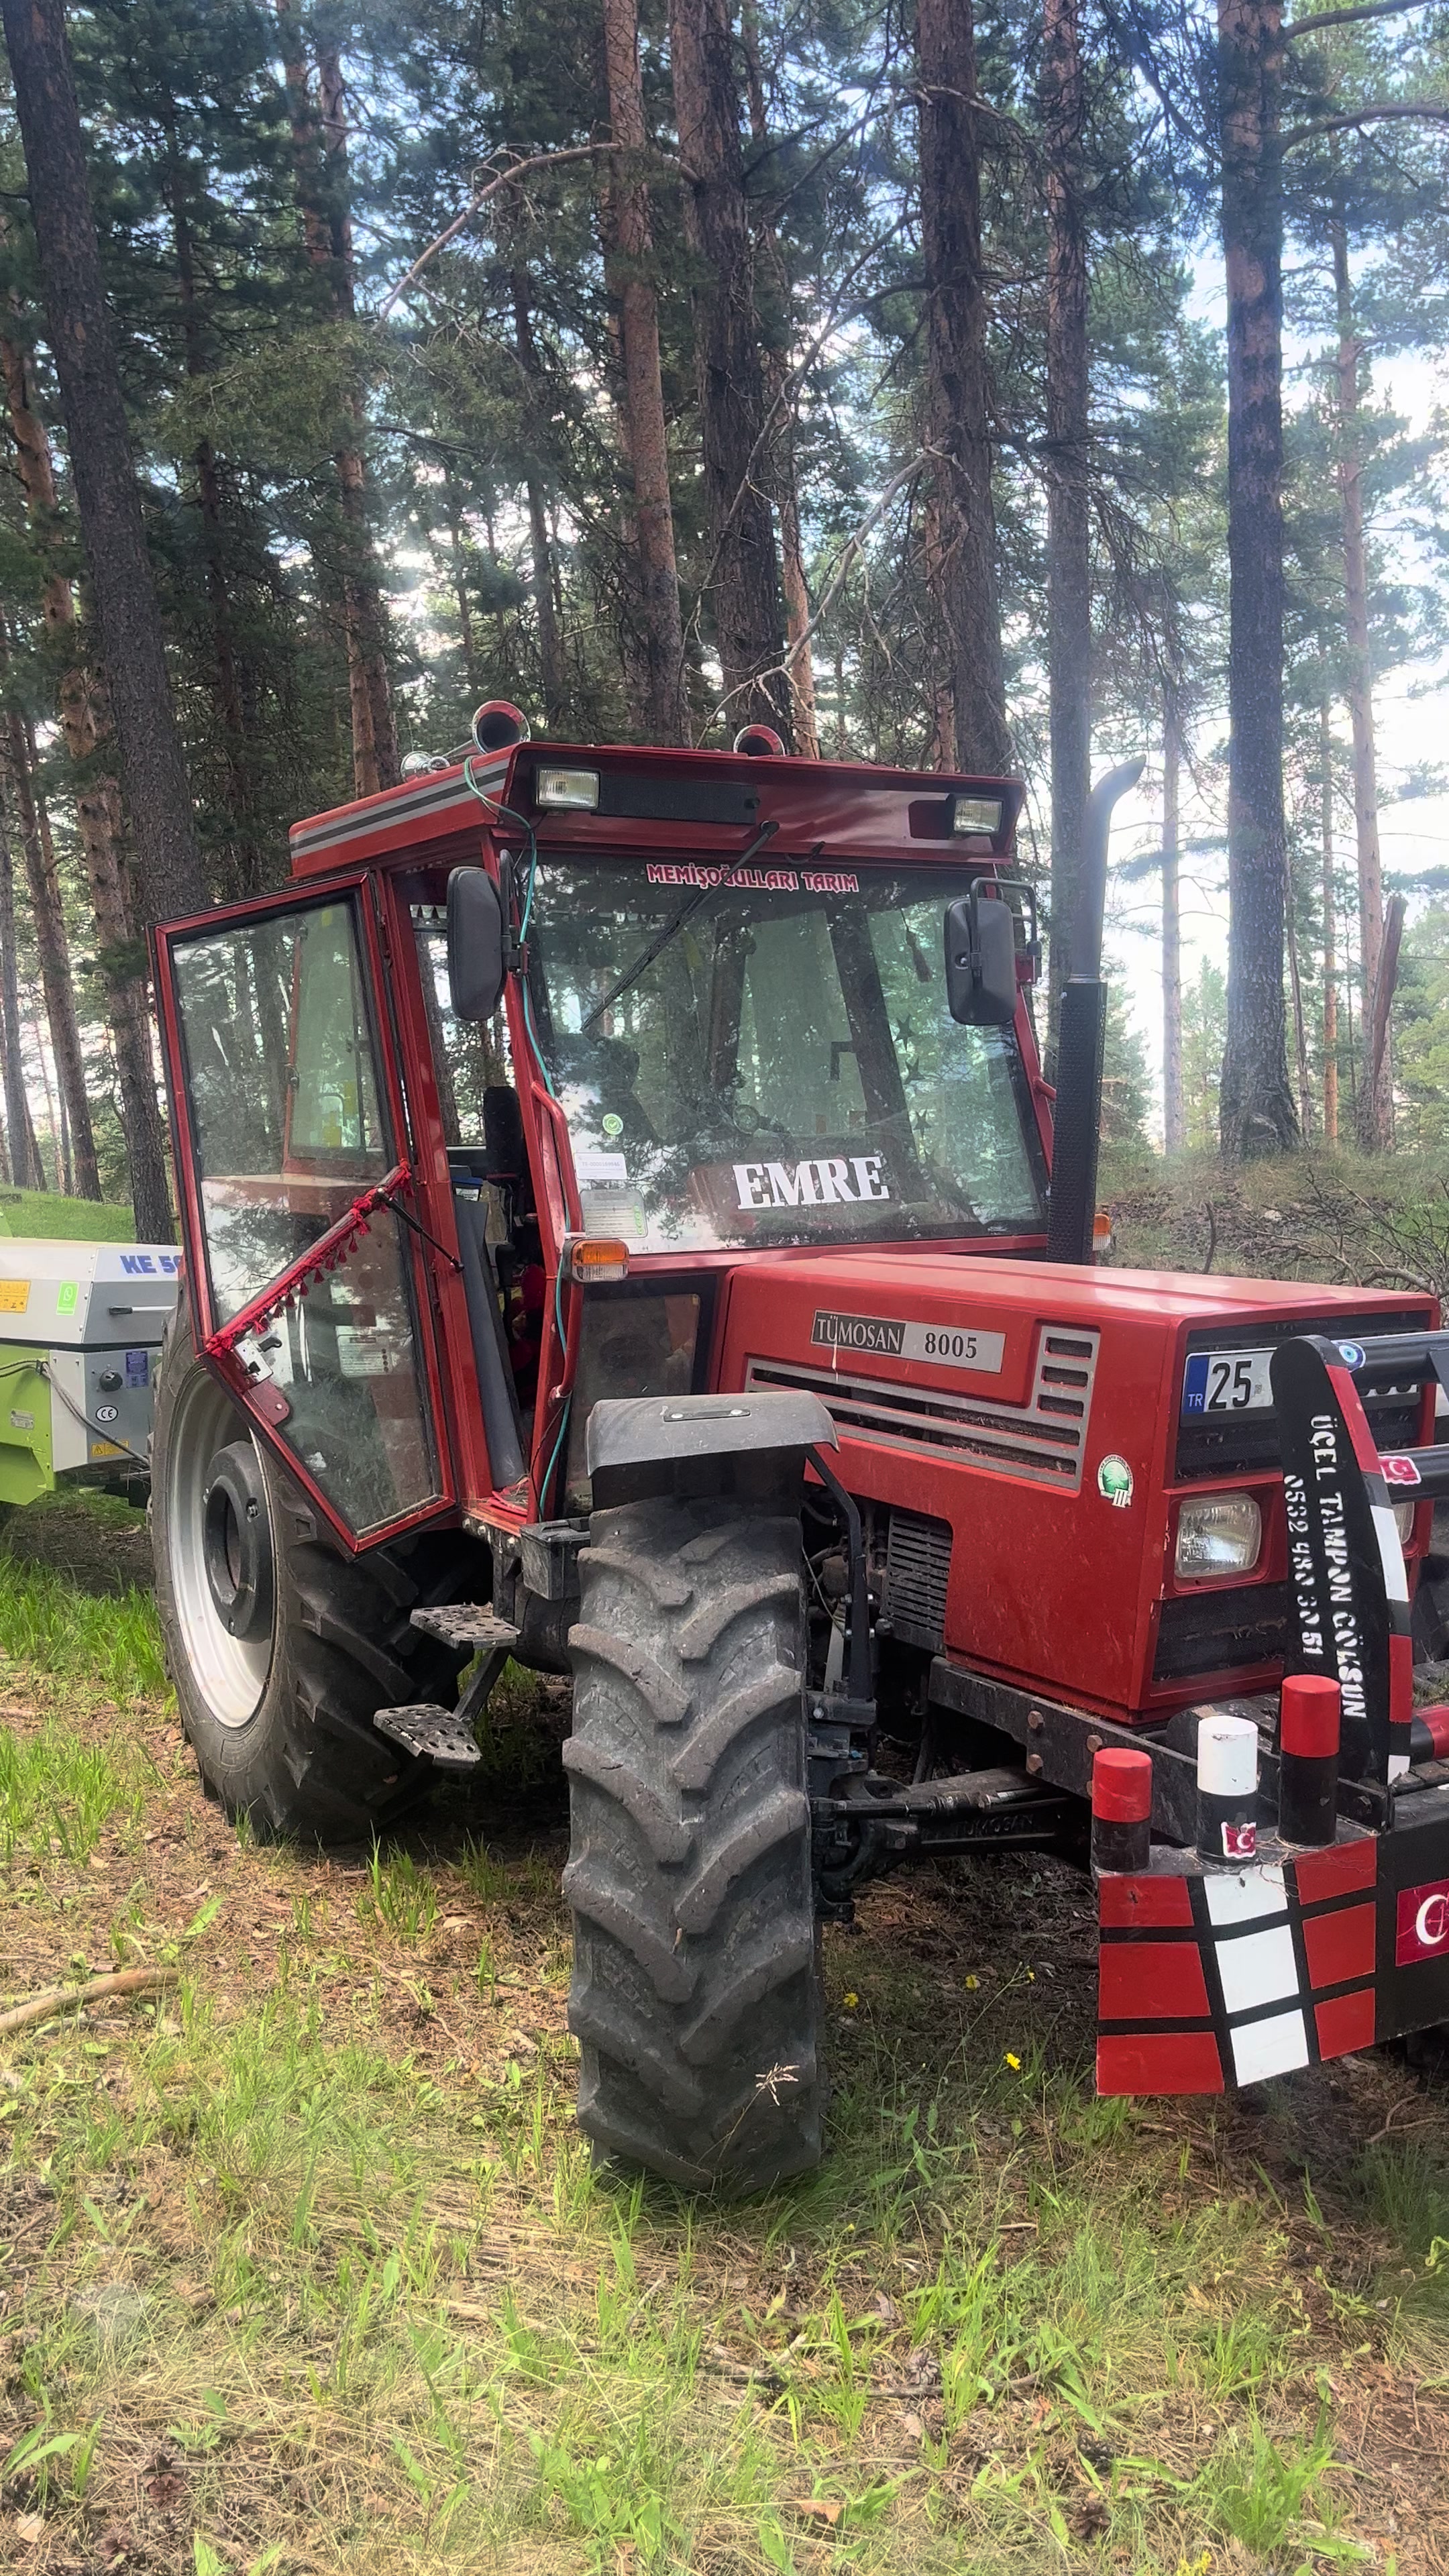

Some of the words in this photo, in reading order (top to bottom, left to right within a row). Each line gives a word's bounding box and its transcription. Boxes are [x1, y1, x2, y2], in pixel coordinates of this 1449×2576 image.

[802, 872, 859, 893] TARIM
[733, 1156, 890, 1210] EMRE
[119, 1255, 157, 1274] KE
[816, 1316, 901, 1351] TÜMOSAN
[924, 1332, 977, 1359] 8005
[1188, 1393, 1203, 1407] TR
[1208, 1360, 1252, 1410] 25
[101, 1409, 113, 1419] CE
[1309, 1415, 1338, 1481] ÜÇEL
[1284, 1475, 1309, 1533] 0532
[1291, 1542, 1315, 1586] 480
[1320, 1491, 1352, 1602] TAMPON
[1297, 1595, 1320, 1624] 30
[1302, 1631, 1324, 1655] 51
[1332, 1611, 1367, 1719] GÖKSUN
